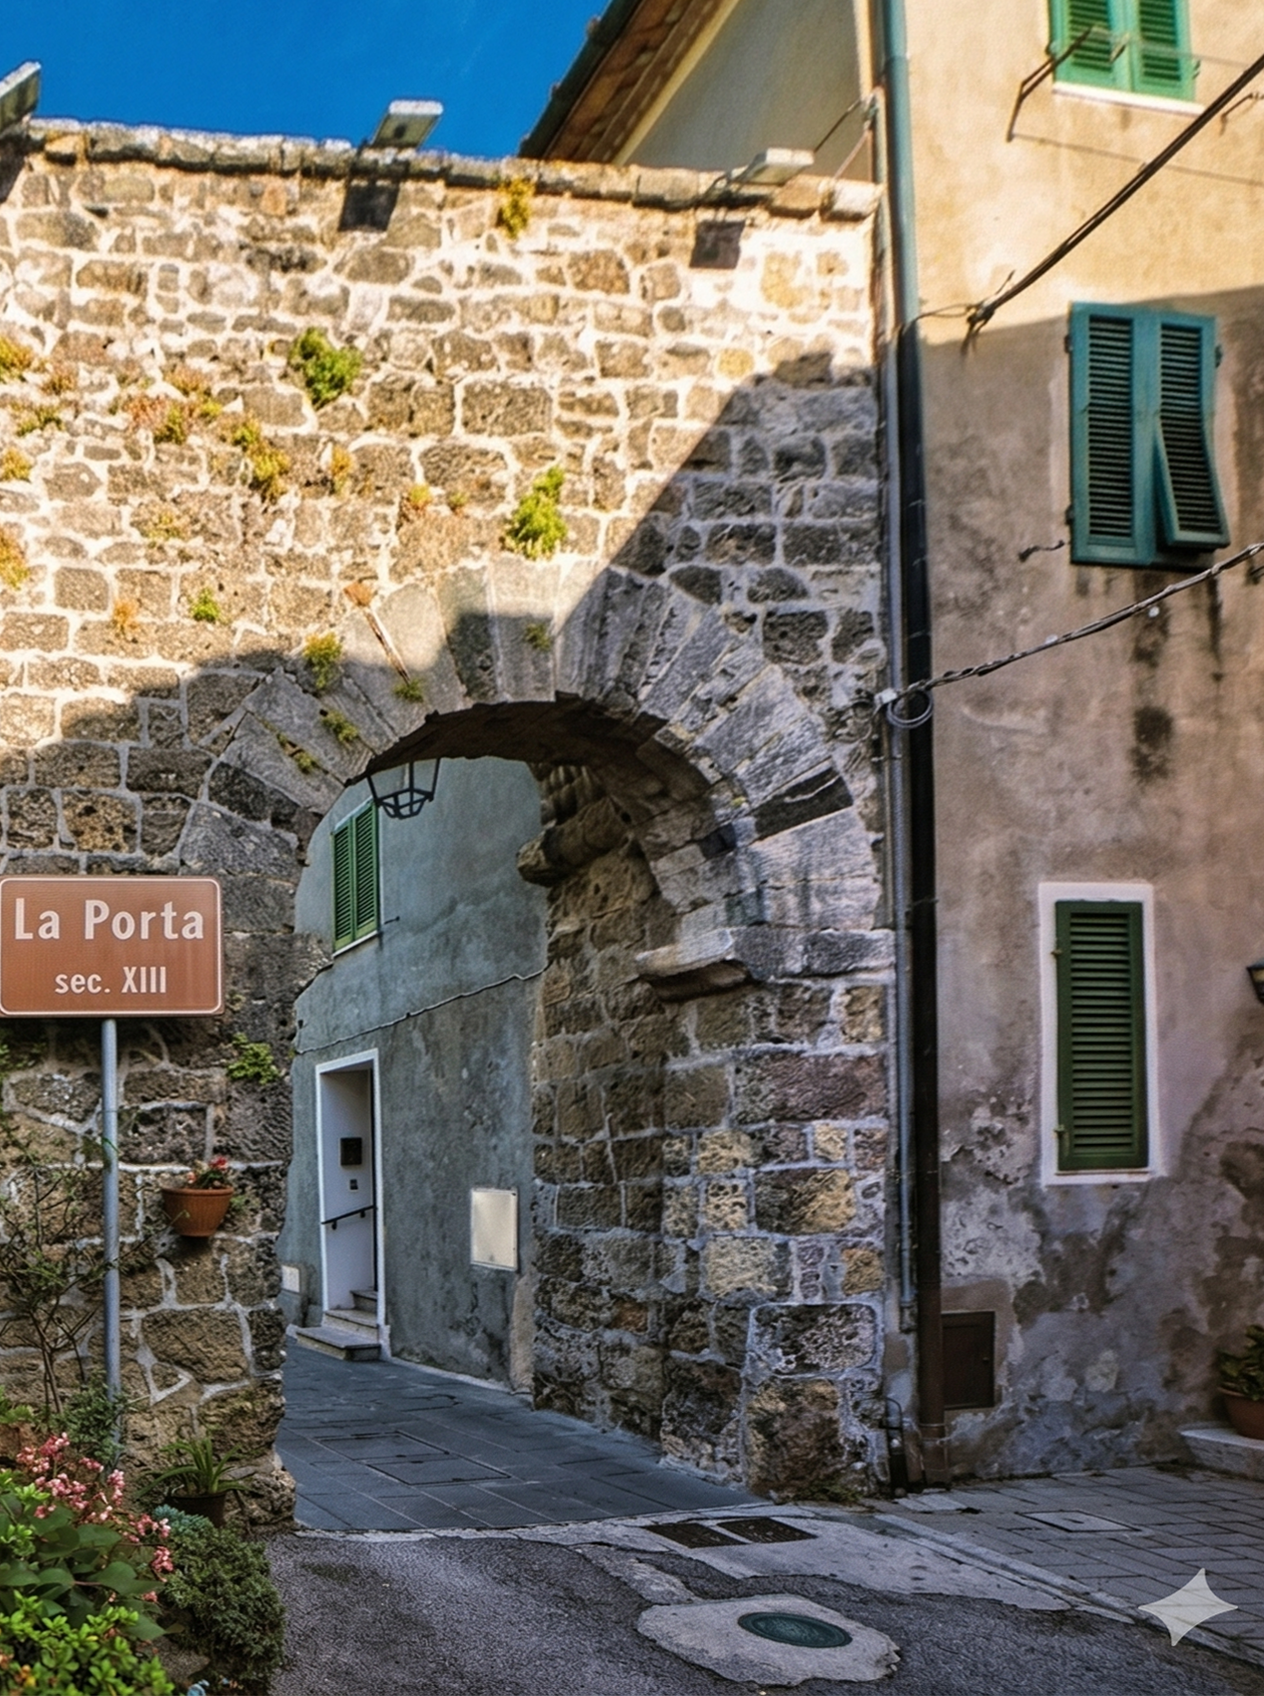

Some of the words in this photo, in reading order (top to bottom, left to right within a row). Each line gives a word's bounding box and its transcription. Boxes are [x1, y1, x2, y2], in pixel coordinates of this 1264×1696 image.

[14, 897, 61, 940] La
[84, 899, 205, 940] Porta
[54, 973, 112, 995] sec.
[121, 966, 167, 994] XIII
